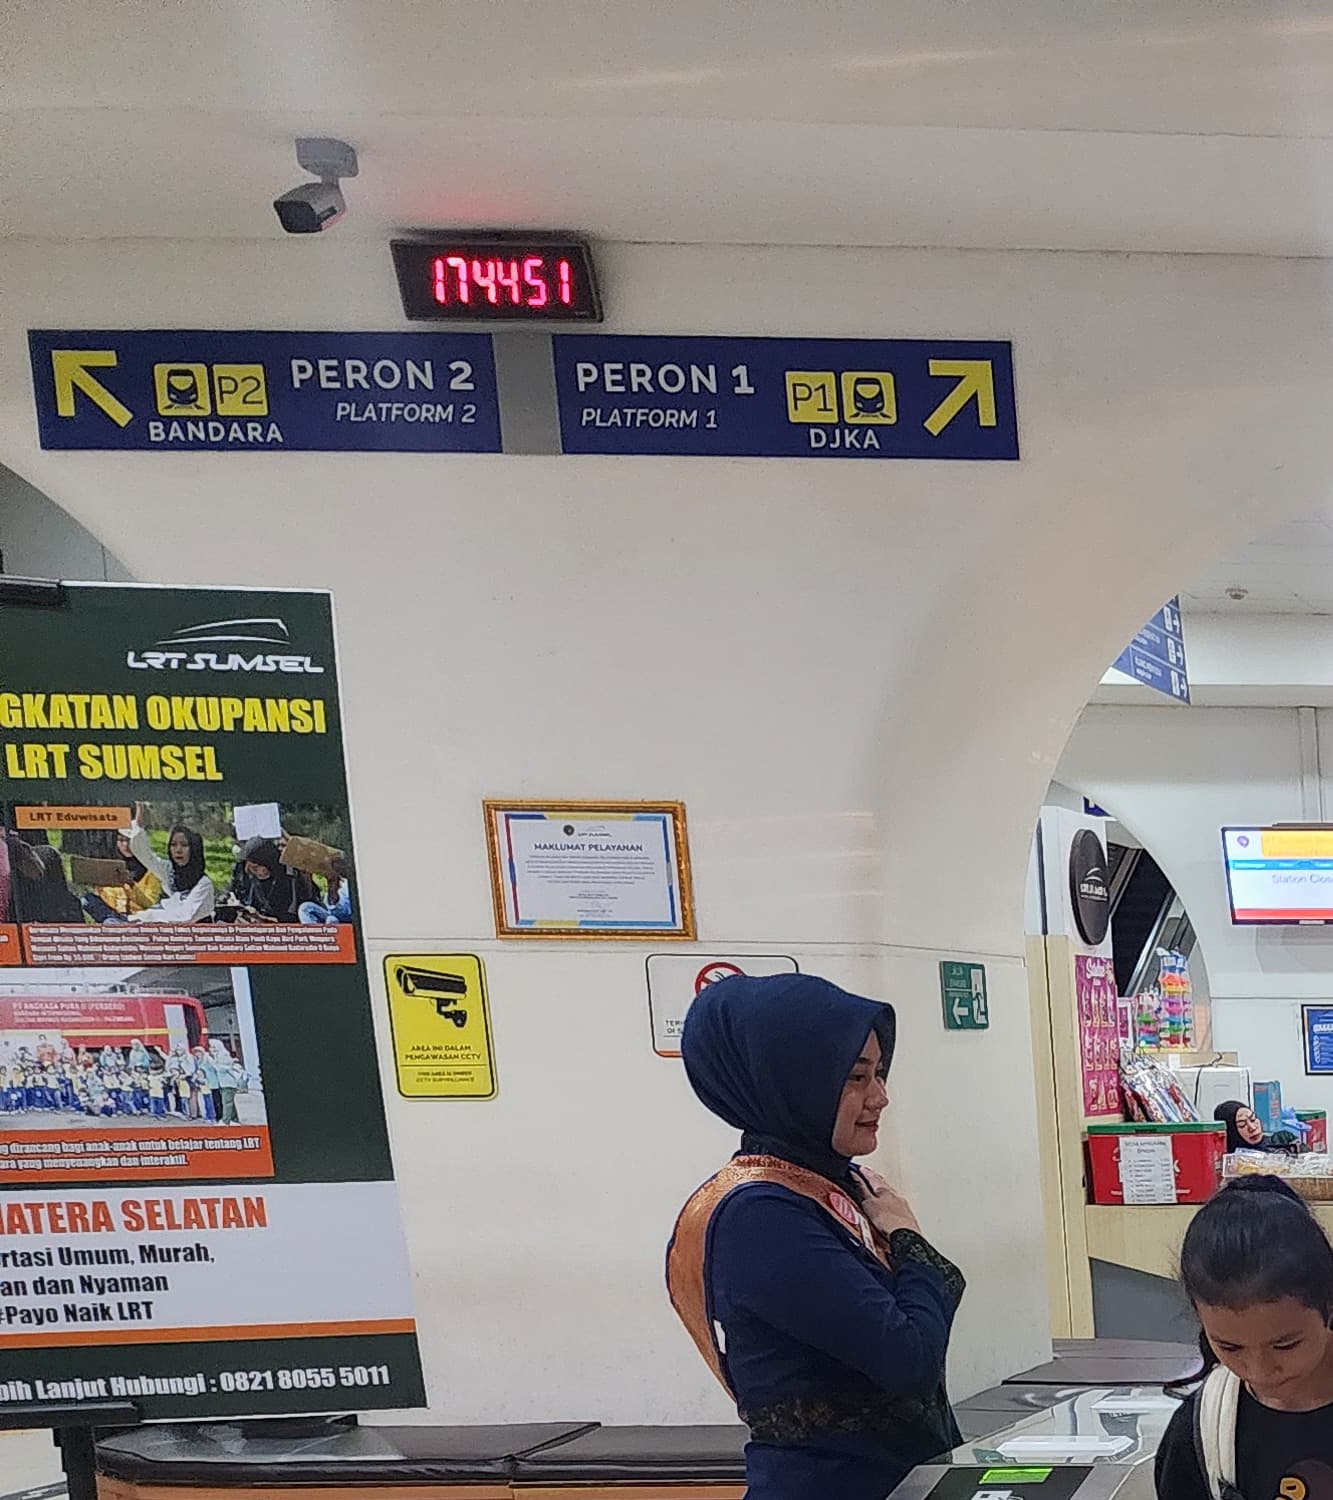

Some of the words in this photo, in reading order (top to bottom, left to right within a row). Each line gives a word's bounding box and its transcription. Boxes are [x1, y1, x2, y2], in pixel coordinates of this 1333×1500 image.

[290, 358, 434, 390] PERON
[449, 361, 475, 391] 2
[576, 363, 718, 394] PERON
[731, 365, 755, 395] 1
[216, 376, 264, 405] P2
[791, 383, 834, 412] P1
[336, 402, 453, 423] PLATFORM
[461, 404, 476, 423] 2
[581, 408, 698, 428] PLATFORM
[705, 410, 718, 429] 1
[149, 421, 283, 443] BANDARA
[809, 428, 881, 449] DJKA
[0, 692, 139, 730] GKATAN
[146, 695, 327, 733] OKUPANSI
[5, 743, 70, 779] LRT
[78, 744, 224, 781] SUMSEL
[29, 812, 52, 822] LRT
[56, 812, 118, 822] Eduwisata
[534, 843, 586, 852] MAKLUMAT
[588, 843, 643, 852] PELAYANAN
[1272, 874, 1307, 884] Station
[139, 1139, 167, 1151] untuk
[168, 1137, 203, 1151] belajar
[204, 1137, 242, 1149] tentang
[243, 1137, 260, 1149] LRT
[119, 1154, 140, 1167] dan
[0, 1201, 115, 1235] ATERA
[121, 1197, 268, 1232] SELATAN
[58, 1246, 135, 1268] Umum,
[139, 1243, 215, 1265] Murah,
[33, 1276, 75, 1295] dan
[79, 1274, 169, 1296] Nyaman
[63, 1302, 114, 1323] Naik
[118, 1301, 154, 1321] LRT
[35, 1377, 108, 1401] Lanjut
[109, 1373, 206, 1398] Hubungi
[220, 1370, 273, 1391] 0821
[278, 1367, 336, 1389] 8055
[339, 1365, 390, 1386] 5011
